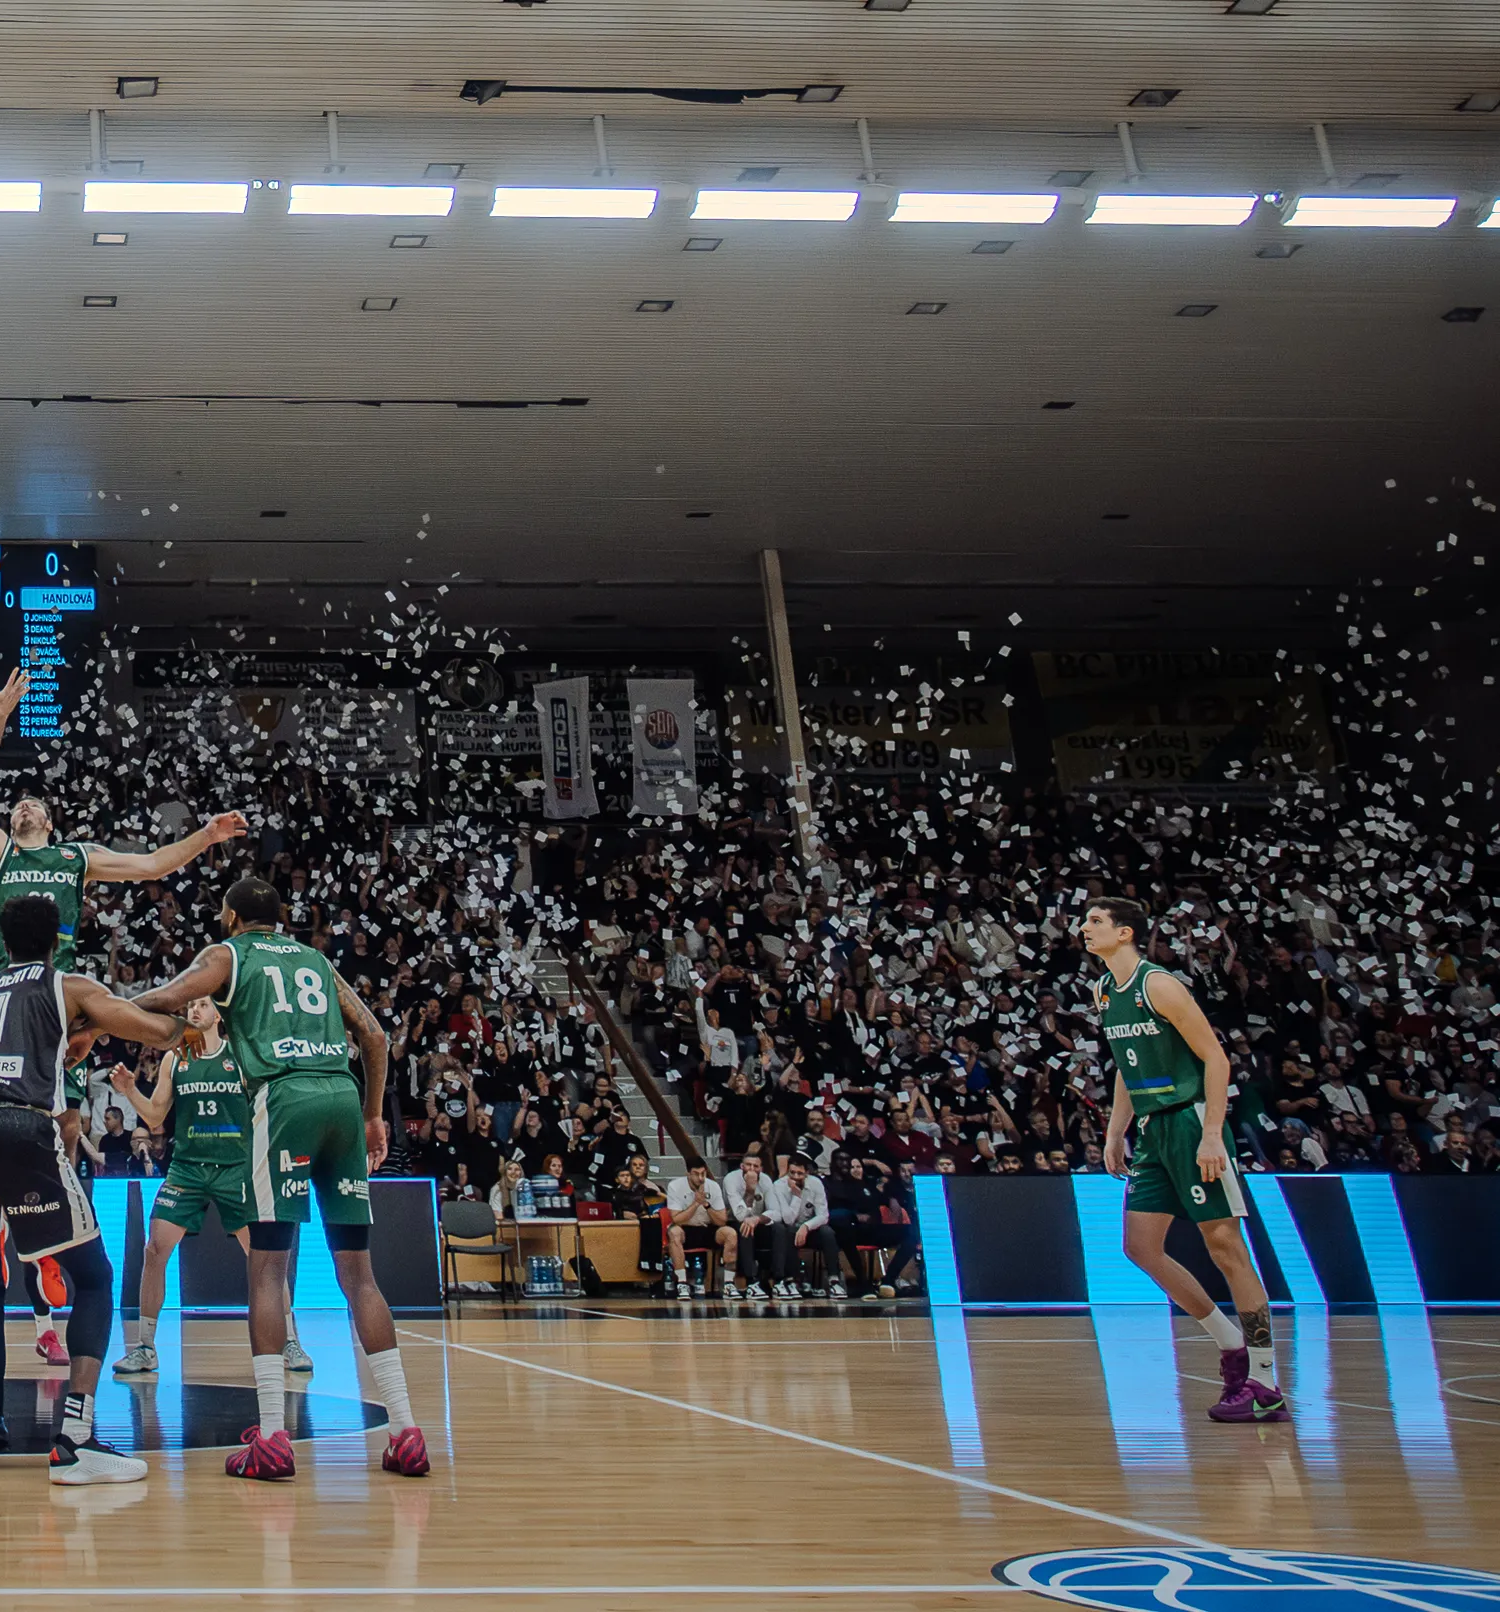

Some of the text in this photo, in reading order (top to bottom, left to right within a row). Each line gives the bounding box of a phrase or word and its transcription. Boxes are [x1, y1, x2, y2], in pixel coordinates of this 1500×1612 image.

[45, 552, 59, 576] 0
[5, 591, 14, 608] 0
[42, 591, 92, 604] HANDLOVÁ
[24, 613, 30, 622] 0
[24, 625, 29, 633] 3
[24, 636, 29, 645] 9
[30, 646, 60, 656] OVÁČIK
[20, 704, 30, 714] 25
[748, 697, 875, 726] Mster
[20, 716, 30, 726] 32
[20, 727, 30, 737] 74
[553, 703, 569, 773] TIPOS
[252, 942, 302, 954] HENSON
[262, 966, 328, 1015] 18
[1126, 1048, 1139, 1067] 9
[197, 1100, 218, 1116] 13
[1190, 1185, 1206, 1205] 9
